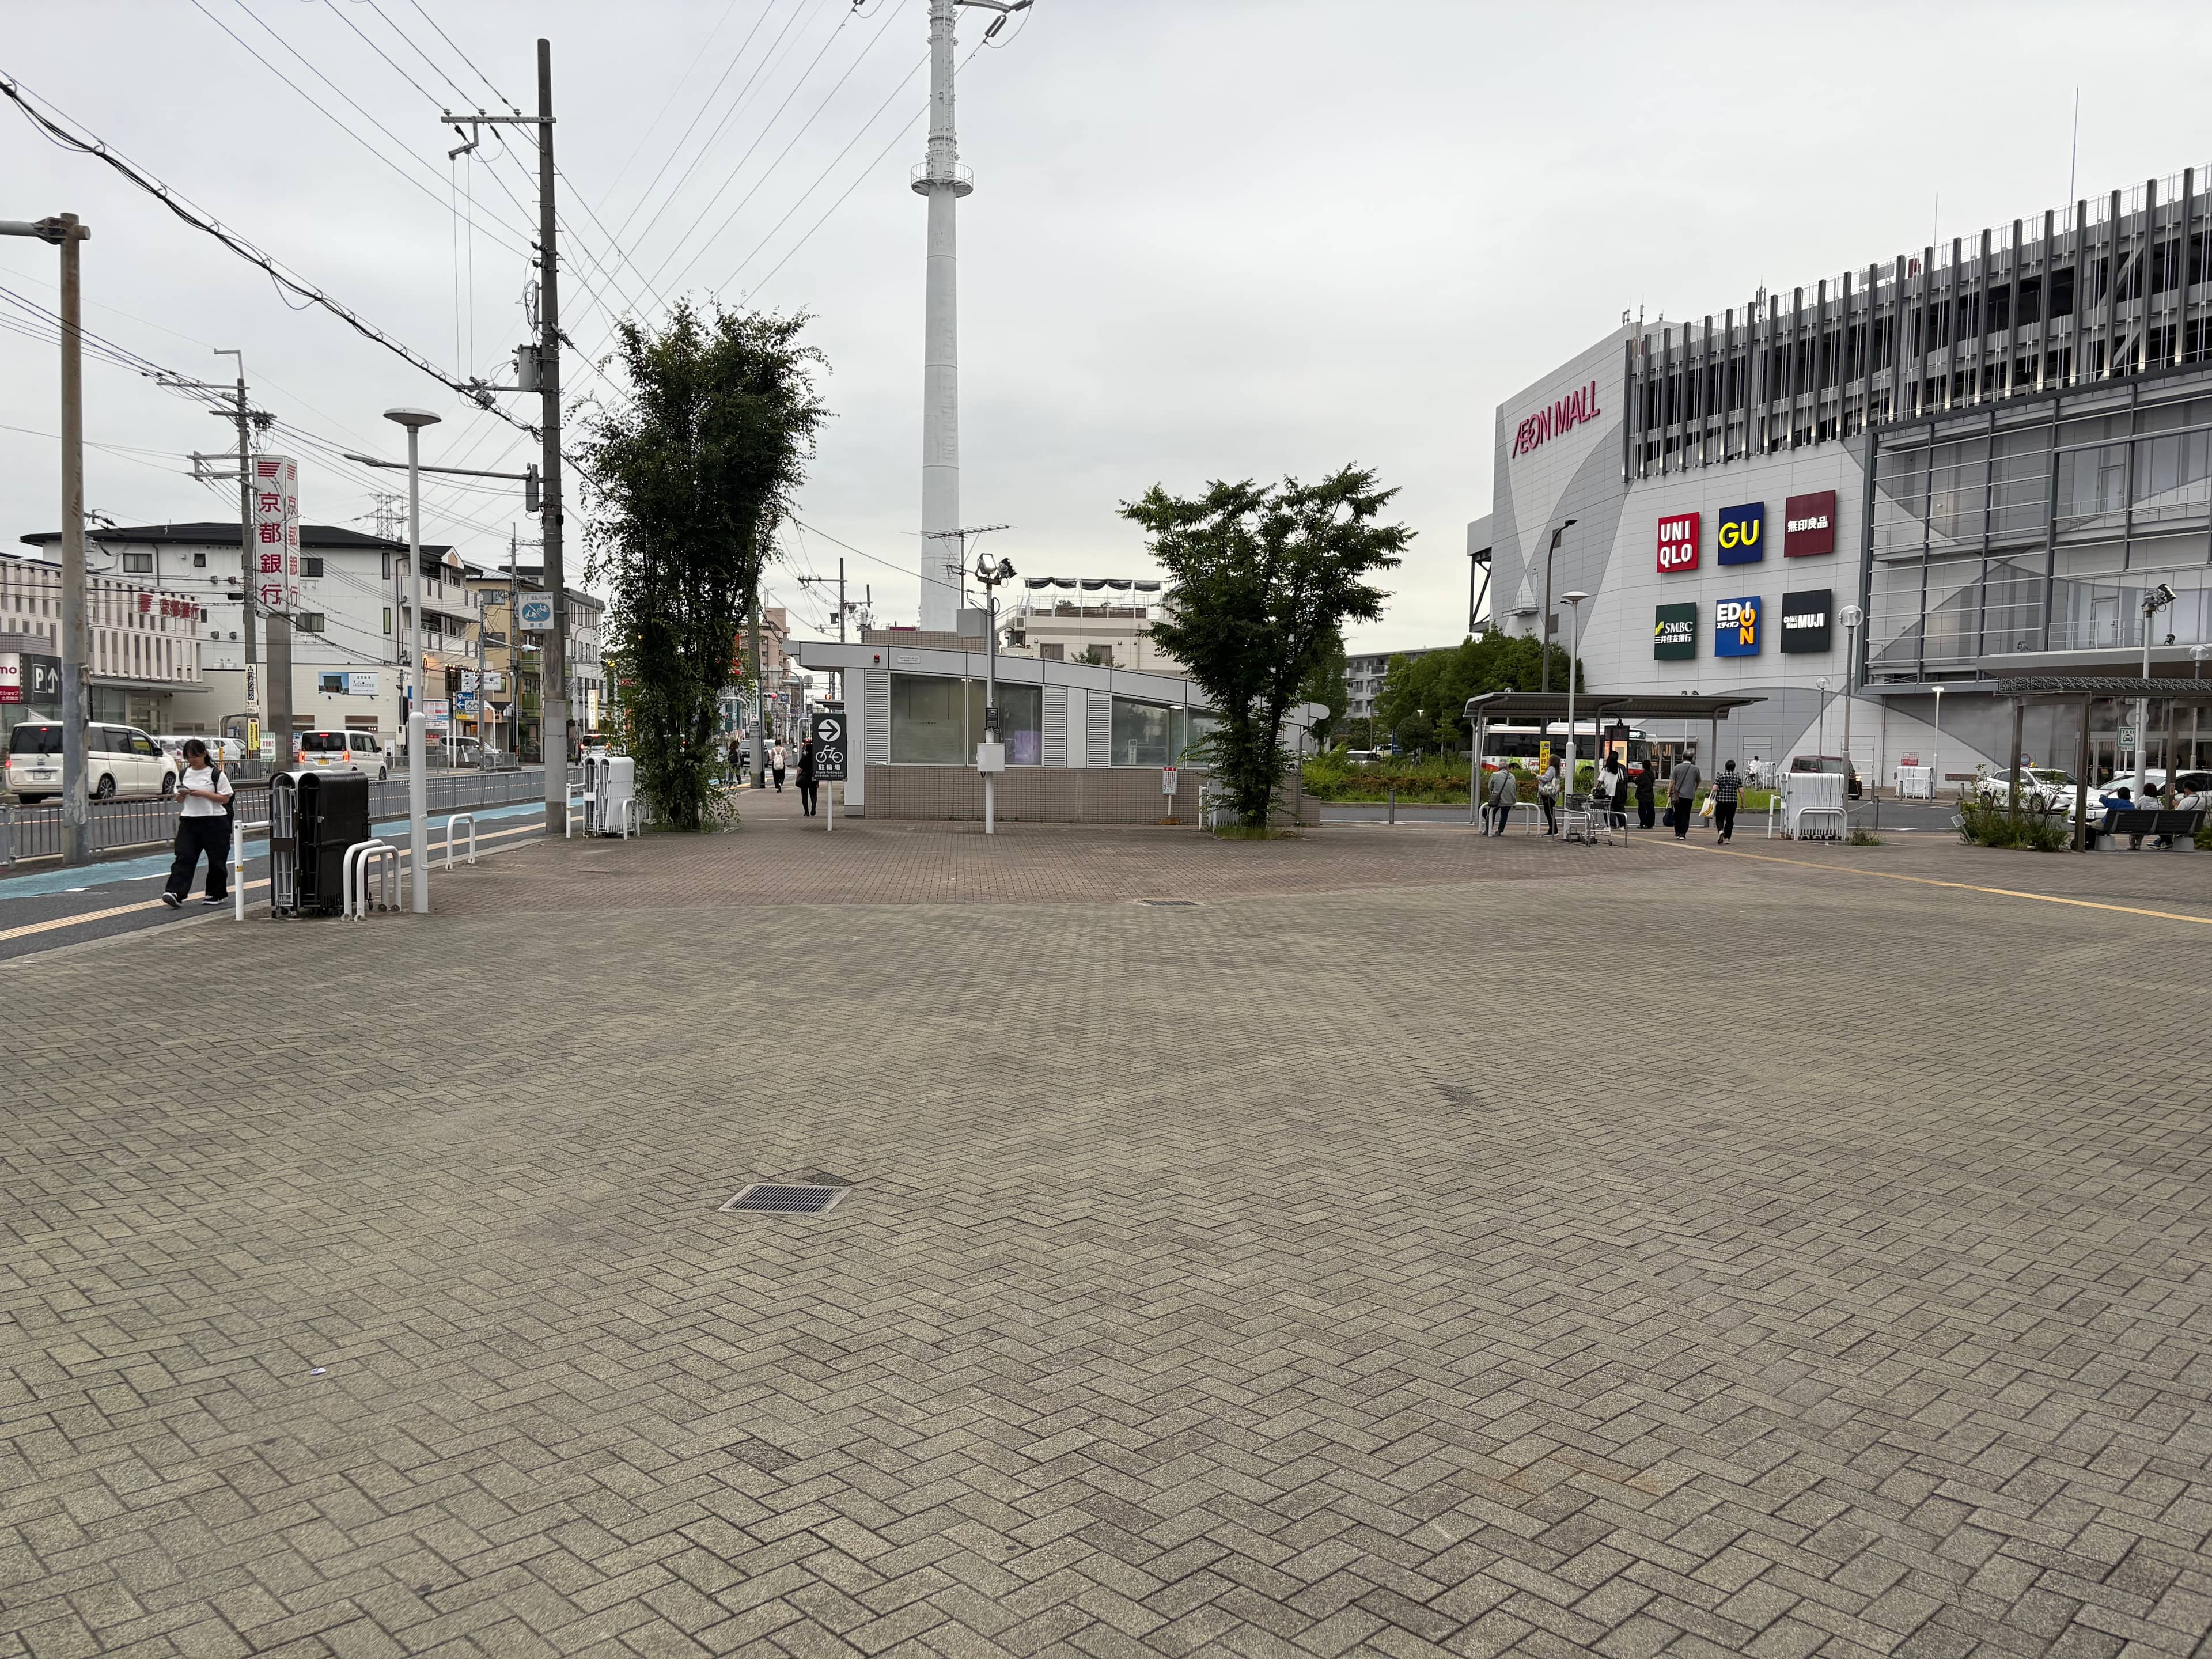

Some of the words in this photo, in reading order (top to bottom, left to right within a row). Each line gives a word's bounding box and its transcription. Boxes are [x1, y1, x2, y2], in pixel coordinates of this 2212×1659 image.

[1554, 381, 1600, 437] MALL
[1661, 520, 1691, 542] UNI
[1719, 520, 1759, 548] GU
[1787, 516, 1829, 532] 無印良品
[259, 492, 282, 605] 京都銀行
[287, 495, 298, 605] 京都銀行
[1660, 543, 1692, 568] QLO
[160, 598, 200, 619] 京都銀行
[1665, 621, 1693, 634] SMBC
[1798, 613, 1825, 628] MUJI
[1654, 634, 1693, 644] 三井住友銀行
[36, 668, 44, 689] P
